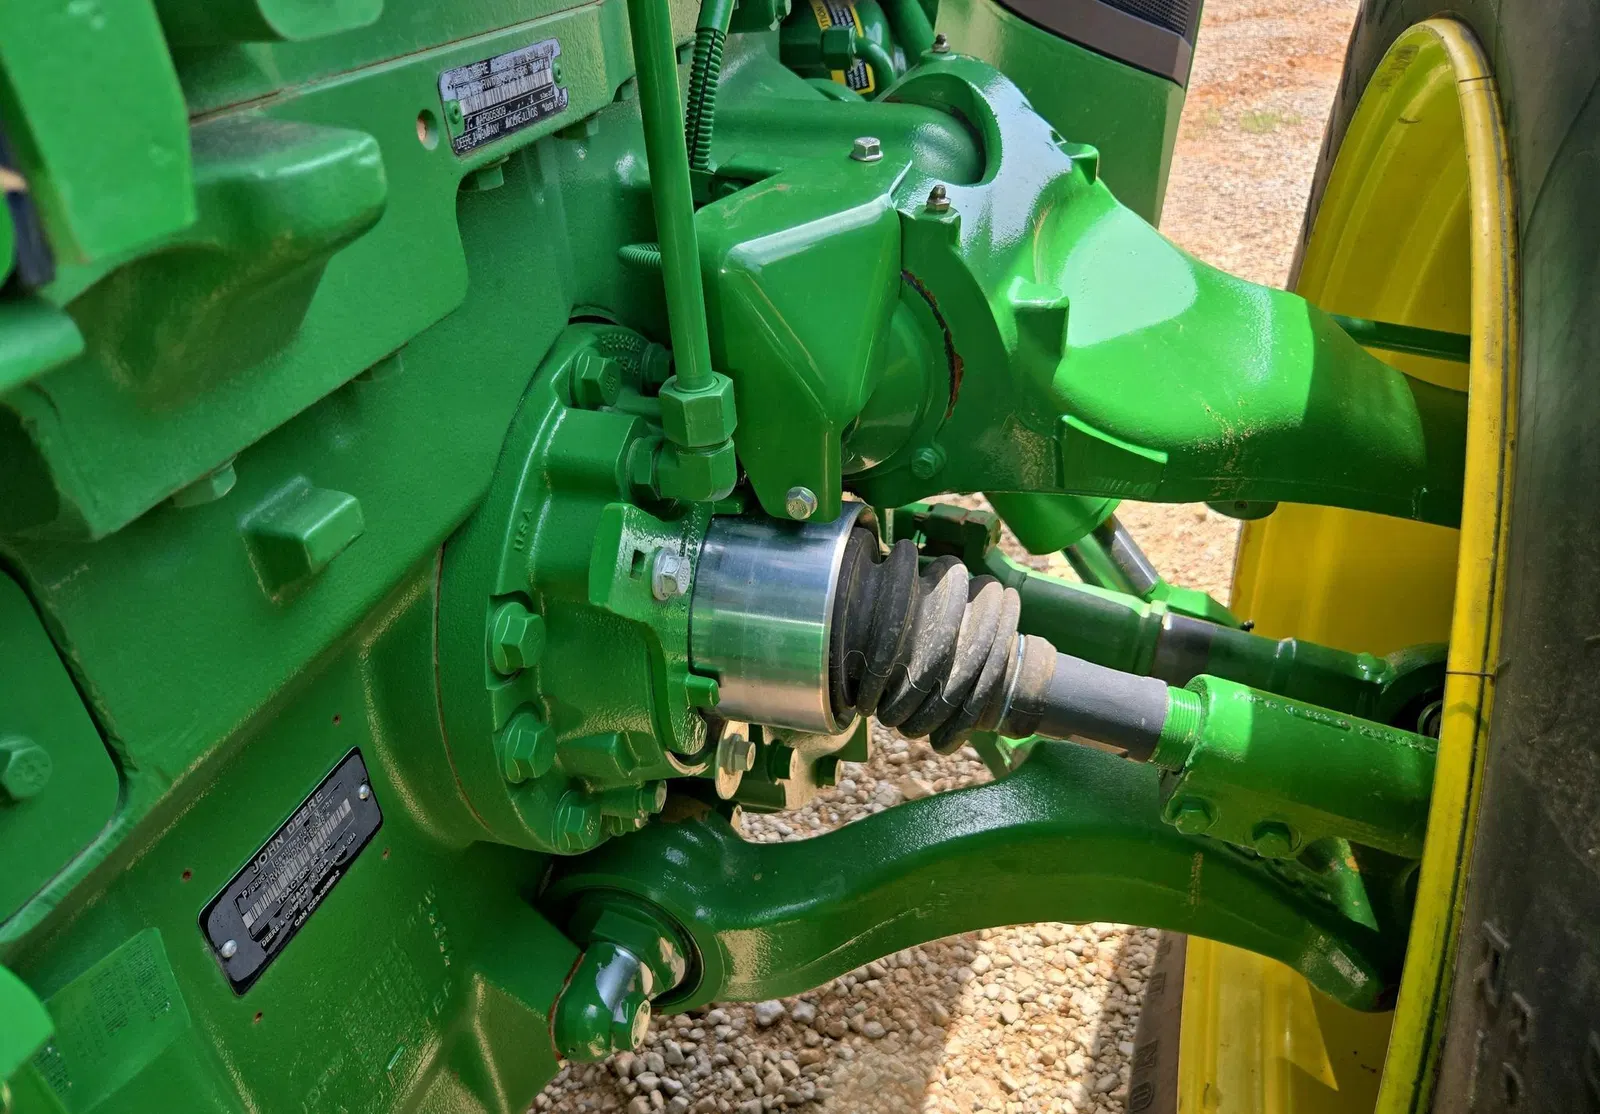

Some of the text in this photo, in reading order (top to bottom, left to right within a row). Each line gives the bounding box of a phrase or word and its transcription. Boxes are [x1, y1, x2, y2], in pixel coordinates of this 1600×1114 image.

[241, 868, 268, 901] Product
[270, 820, 311, 869] Identification
[250, 789, 324, 875] JOHN DEERE
[261, 922, 280, 948] DEERE
[346, 830, 356, 846] USA
[275, 863, 309, 907] TRACTOR
[319, 838, 331, 855] 340
[290, 855, 328, 905] MADE IN USA
[294, 908, 307, 928] CAN
